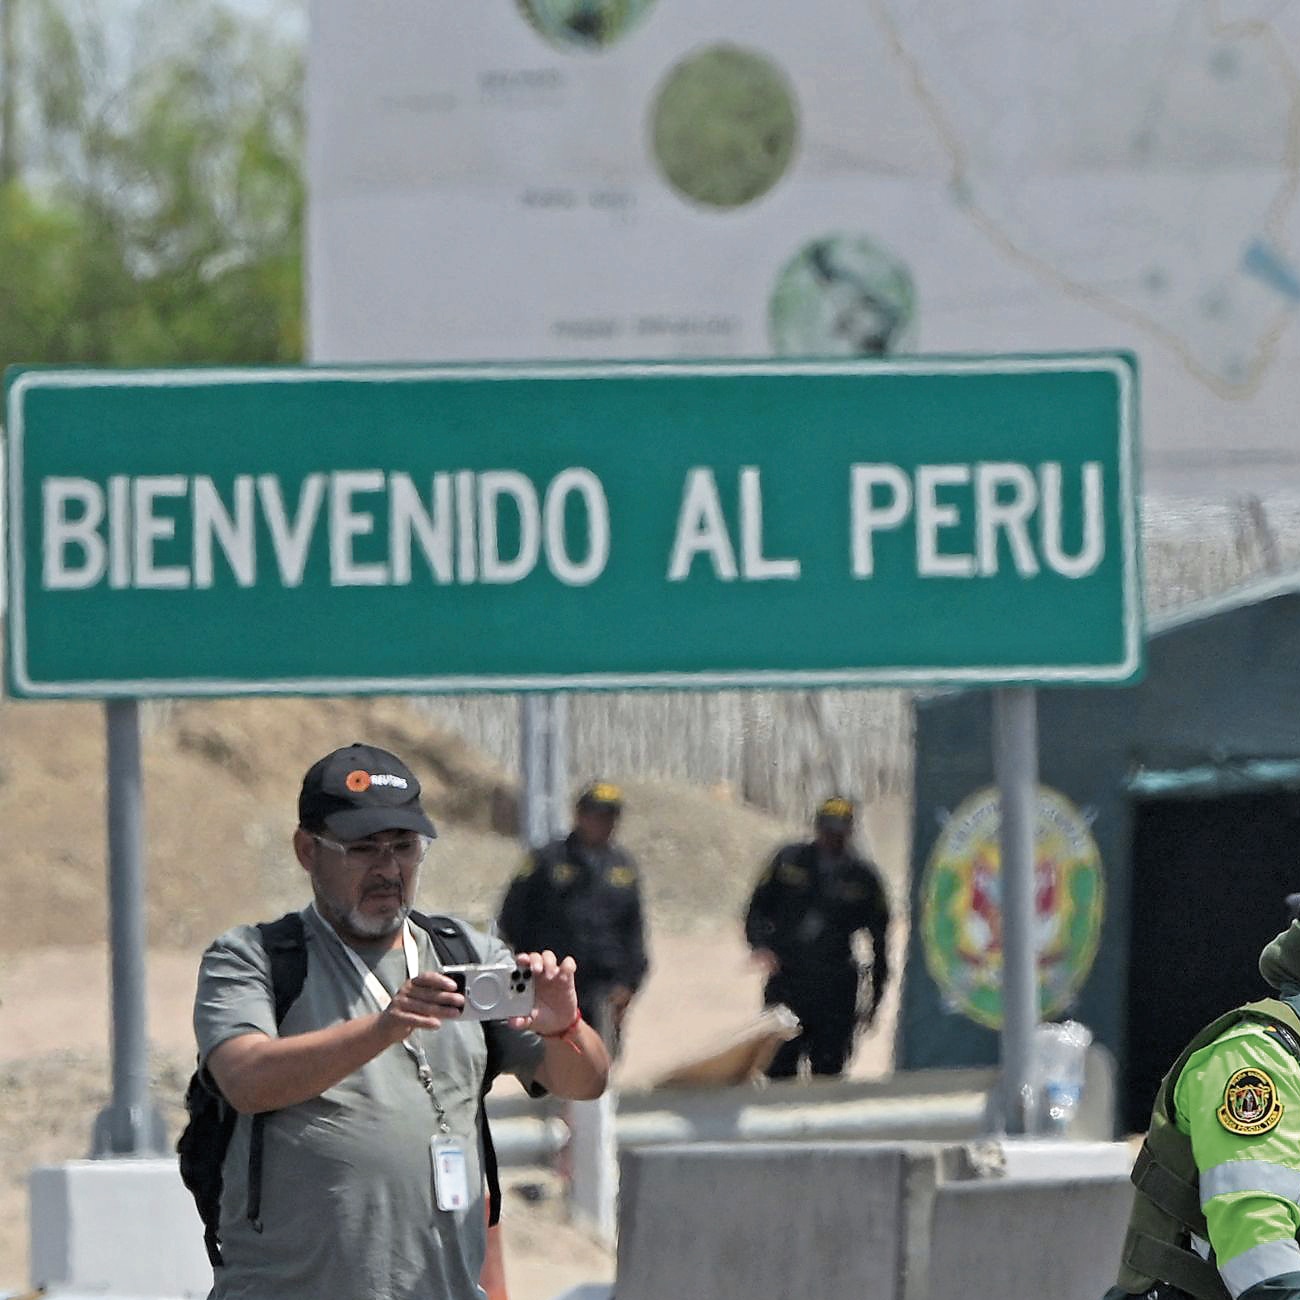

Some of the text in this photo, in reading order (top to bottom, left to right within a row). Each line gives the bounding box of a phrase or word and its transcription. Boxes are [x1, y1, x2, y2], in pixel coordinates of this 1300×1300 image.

[41, 462, 1105, 590] BIENVENIDO AL PERU
